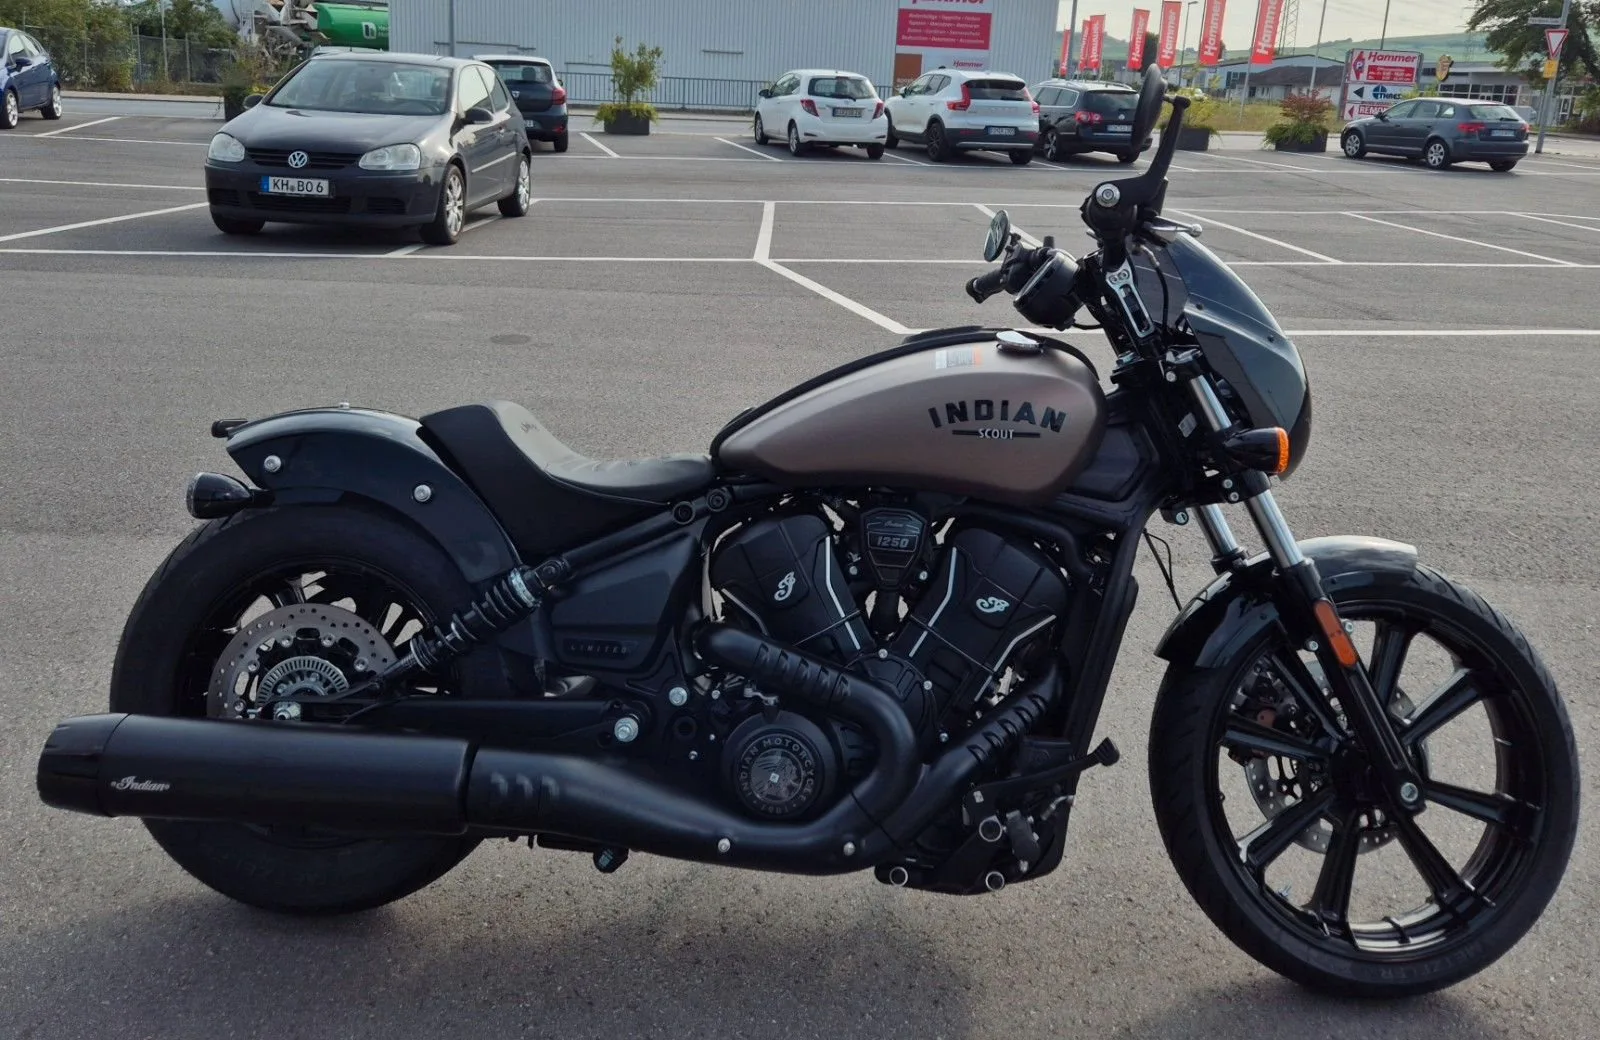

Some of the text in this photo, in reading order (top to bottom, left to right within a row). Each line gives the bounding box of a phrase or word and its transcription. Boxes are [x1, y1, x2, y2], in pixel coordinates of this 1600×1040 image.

[1161, 9, 1176, 59] Hammer
[1256, 0, 1278, 55] Hamme
[1131, 16, 1145, 62] Hammer
[953, 60, 983, 68] Hammer
[1368, 51, 1417, 62] Hammer
[273, 179, 324, 193] KH BO 6
[928, 399, 1067, 433] INDIAN
[978, 428, 1014, 440] SCOUT
[877, 536, 909, 548] 1250
[571, 645, 627, 654] LIMITED
[740, 746, 759, 796] INDIAN
[116, 775, 165, 791] Indian
